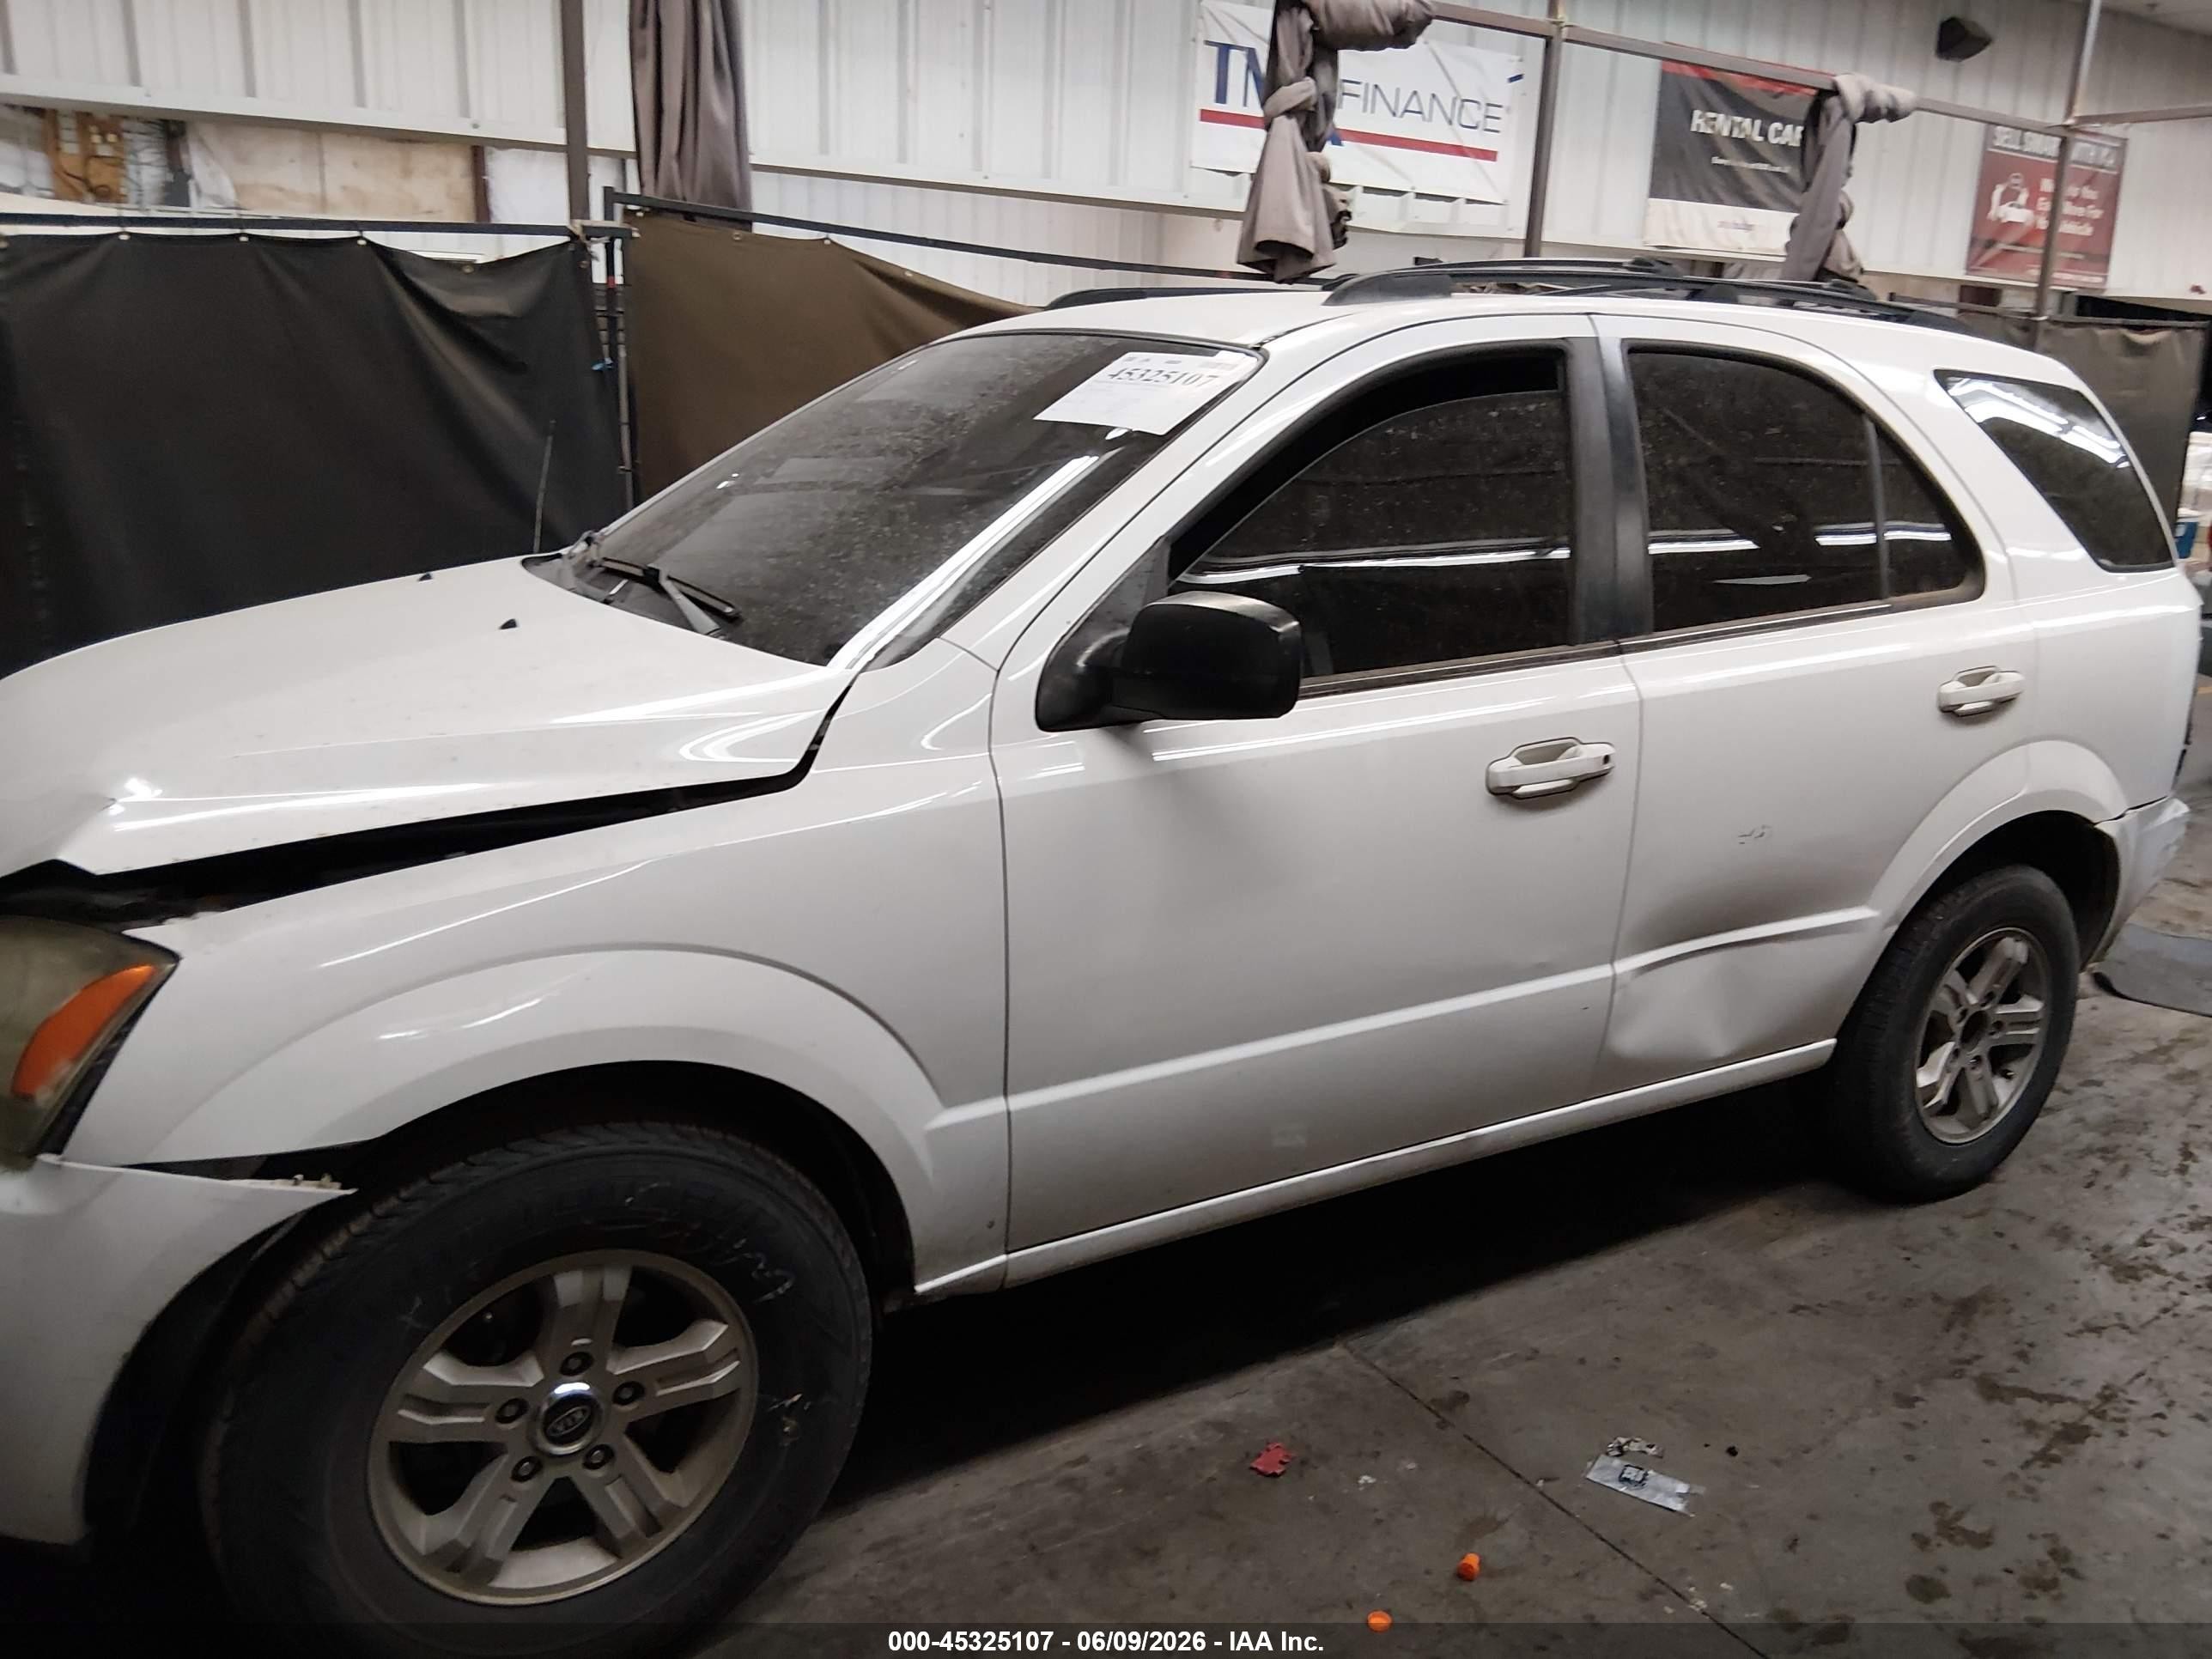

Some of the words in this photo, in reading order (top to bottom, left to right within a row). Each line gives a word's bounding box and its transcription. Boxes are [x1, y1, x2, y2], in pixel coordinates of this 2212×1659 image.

[1339, 78, 1503, 134] FINANCE
[1689, 108, 1764, 142] RENTAL
[1107, 367, 1218, 386] 45325107
